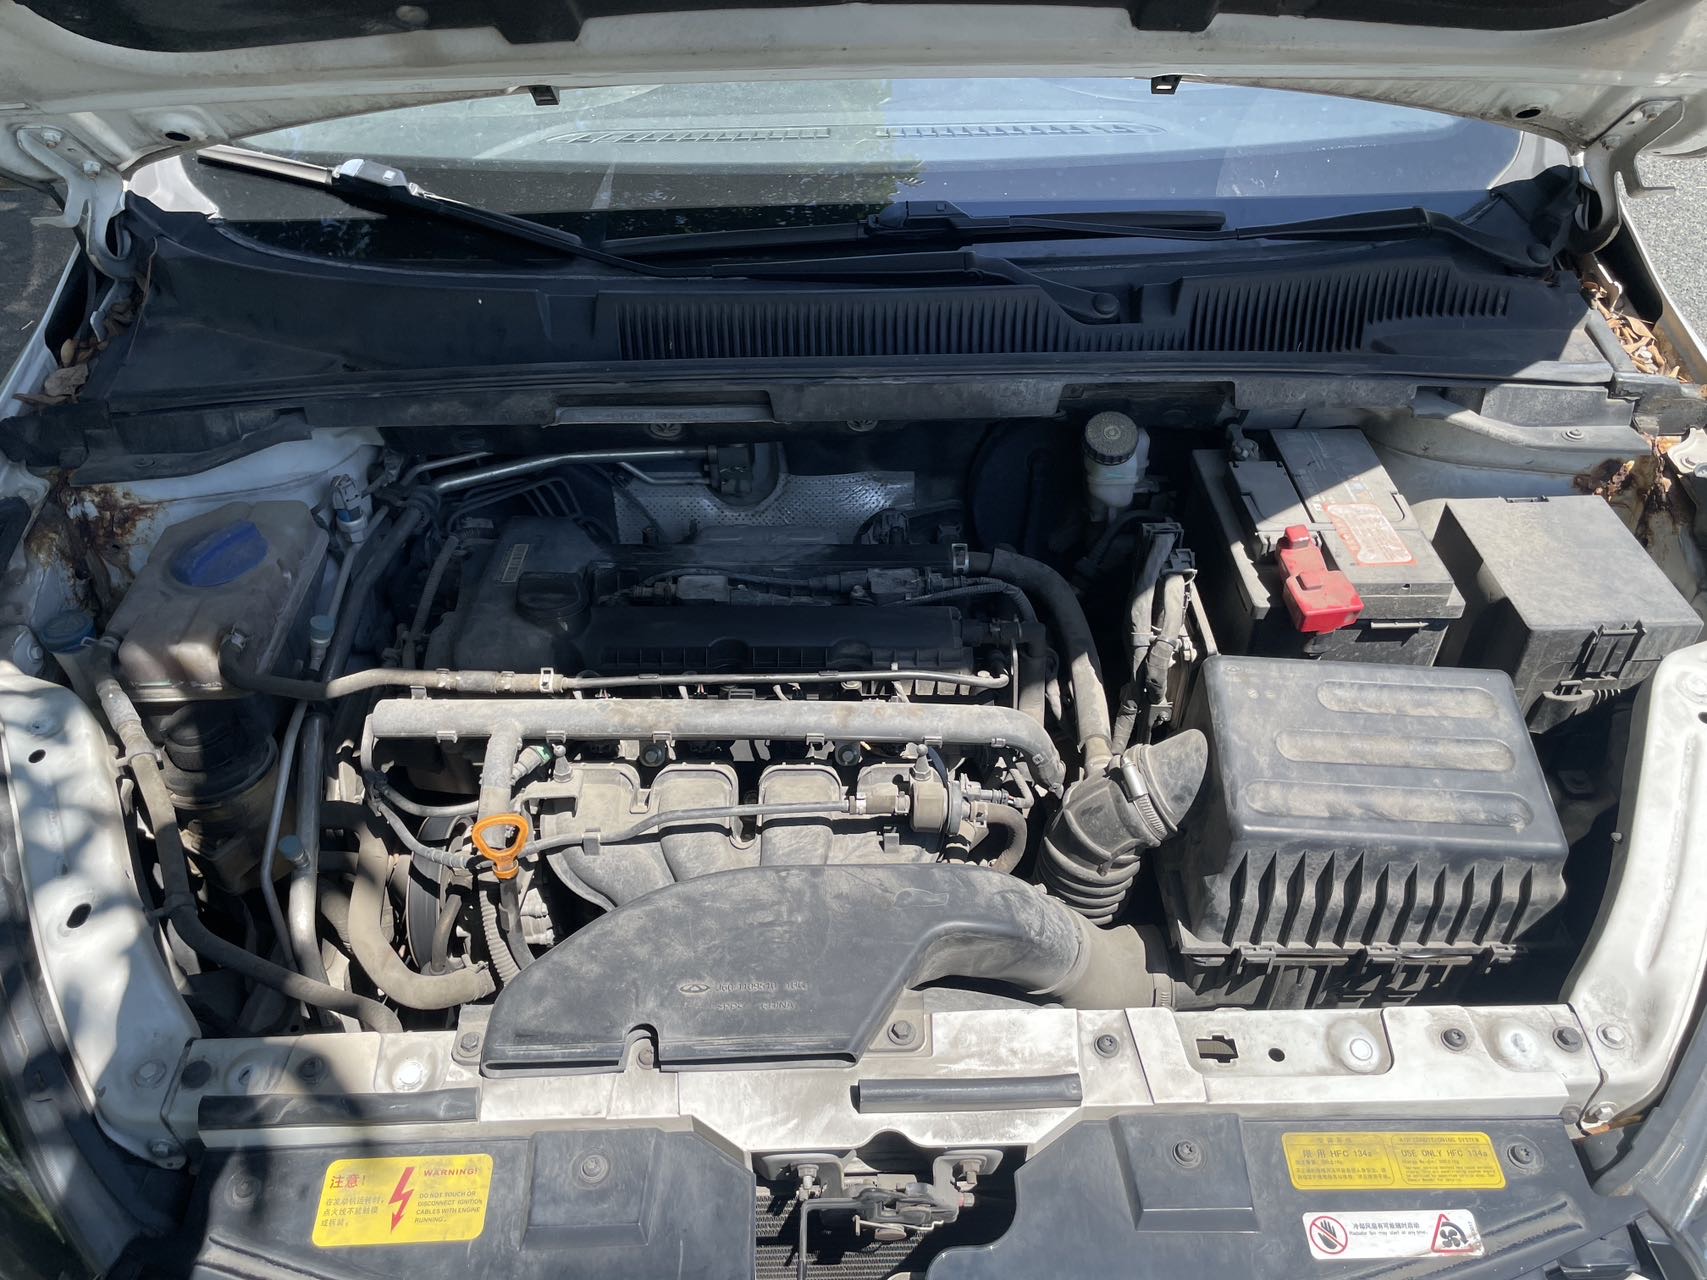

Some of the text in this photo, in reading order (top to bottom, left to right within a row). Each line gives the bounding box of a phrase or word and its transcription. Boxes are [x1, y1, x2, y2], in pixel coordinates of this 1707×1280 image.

[1330, 1150, 1349, 1158] HFC
[1401, 1149, 1417, 1157] USE
[1423, 1149, 1442, 1157] ONLY
[1446, 1149, 1463, 1157] HFC
[424, 1168, 478, 1177] WARNING!
